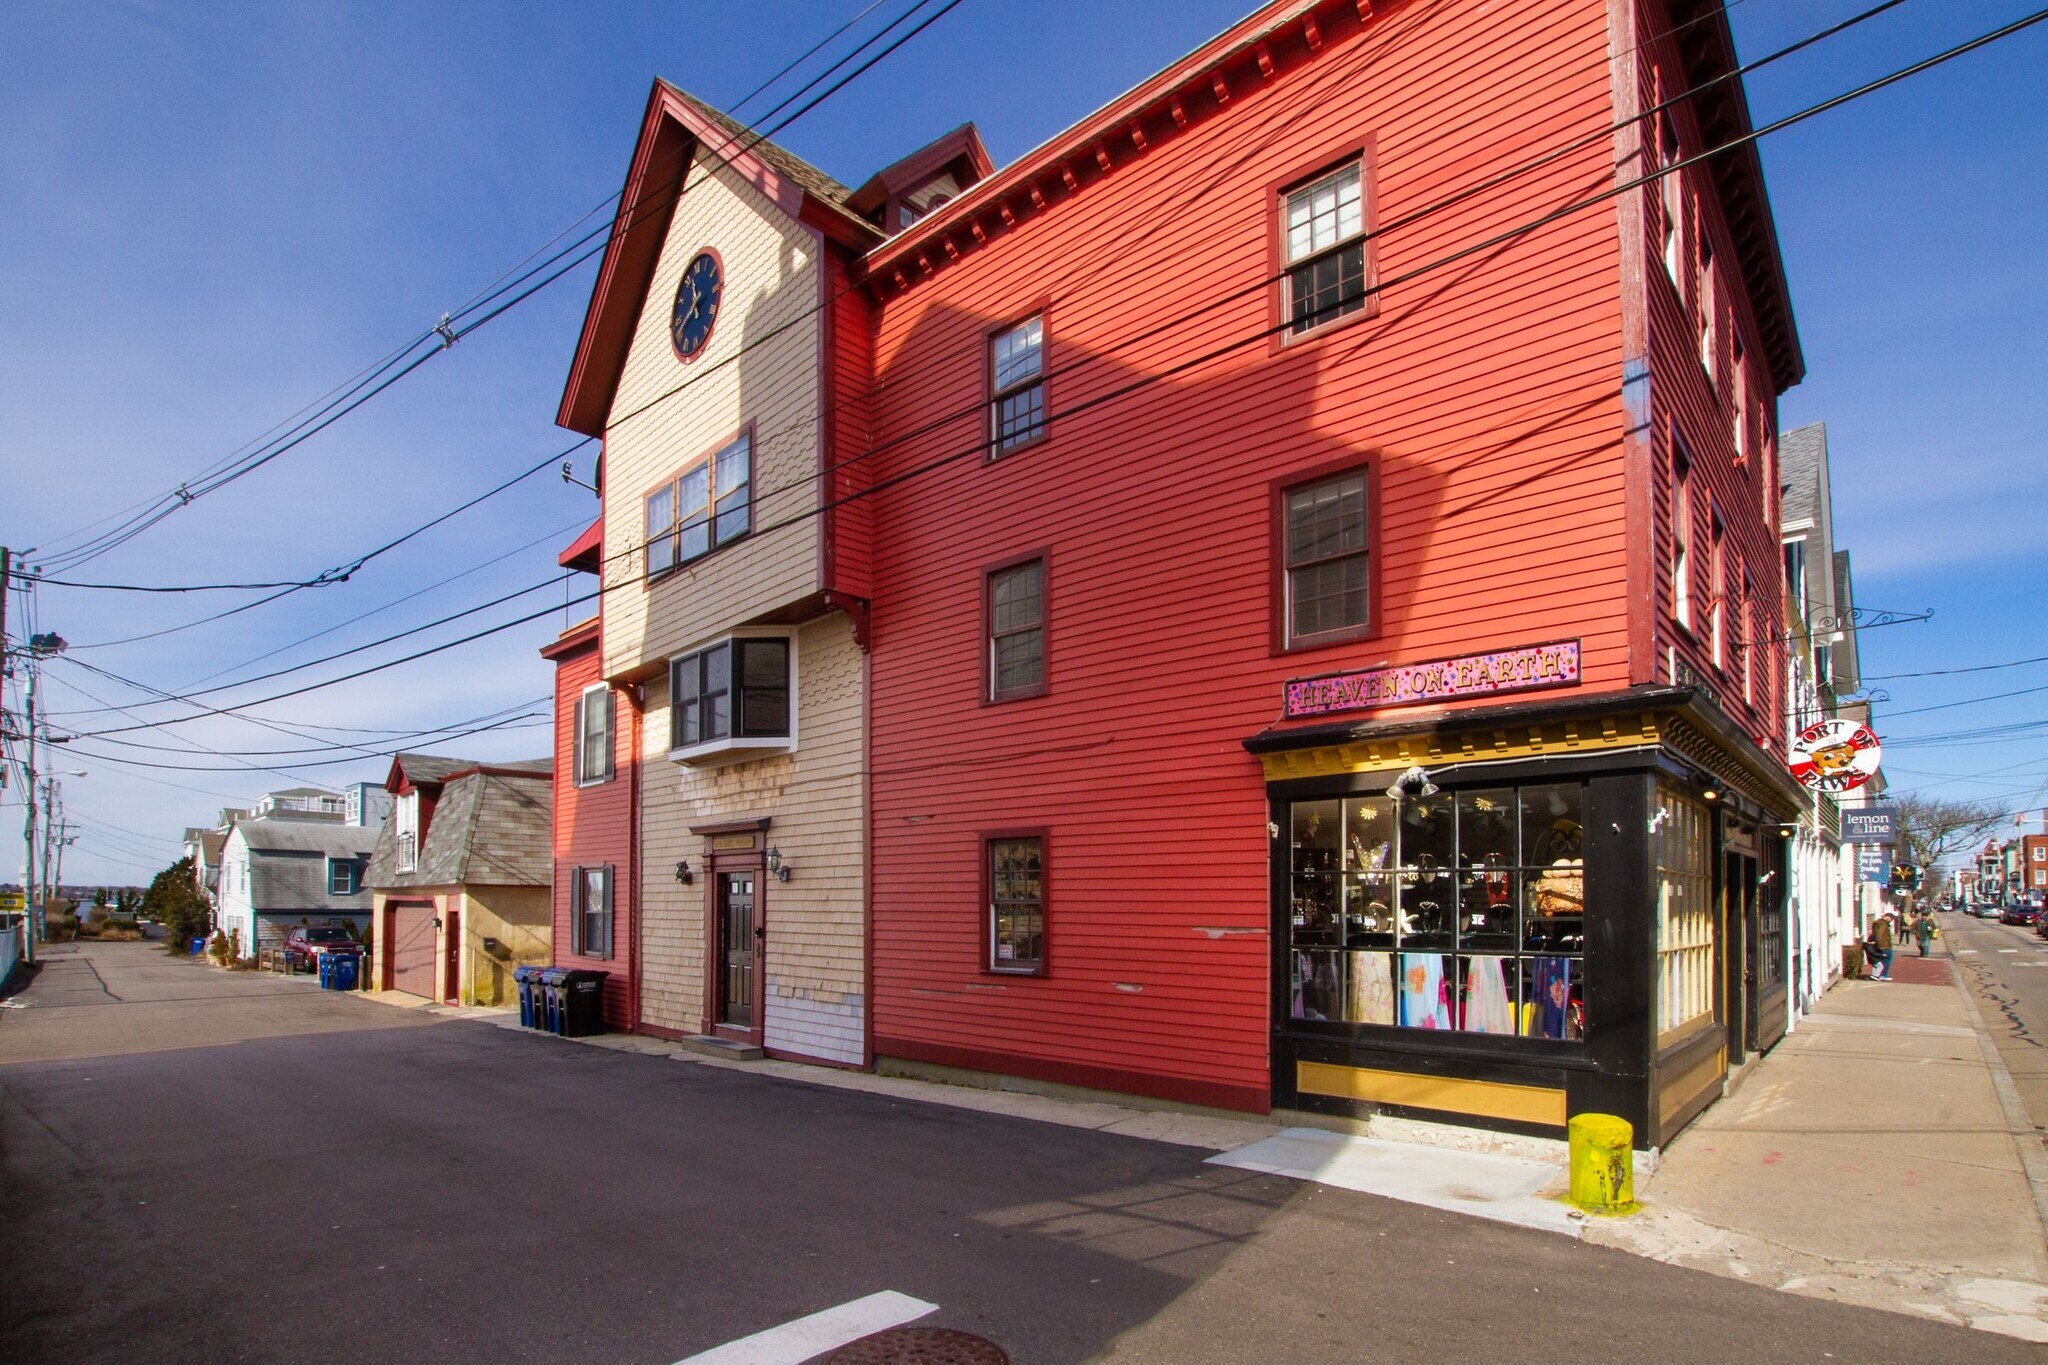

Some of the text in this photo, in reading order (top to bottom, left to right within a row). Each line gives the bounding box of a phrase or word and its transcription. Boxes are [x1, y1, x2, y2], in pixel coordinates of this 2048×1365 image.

[1300, 651, 1564, 709] HEAVEN ON EARTH
[1793, 722, 1877, 753] PORT OF
[1847, 814, 1889, 824] lemon
[1864, 824, 1890, 833] line
